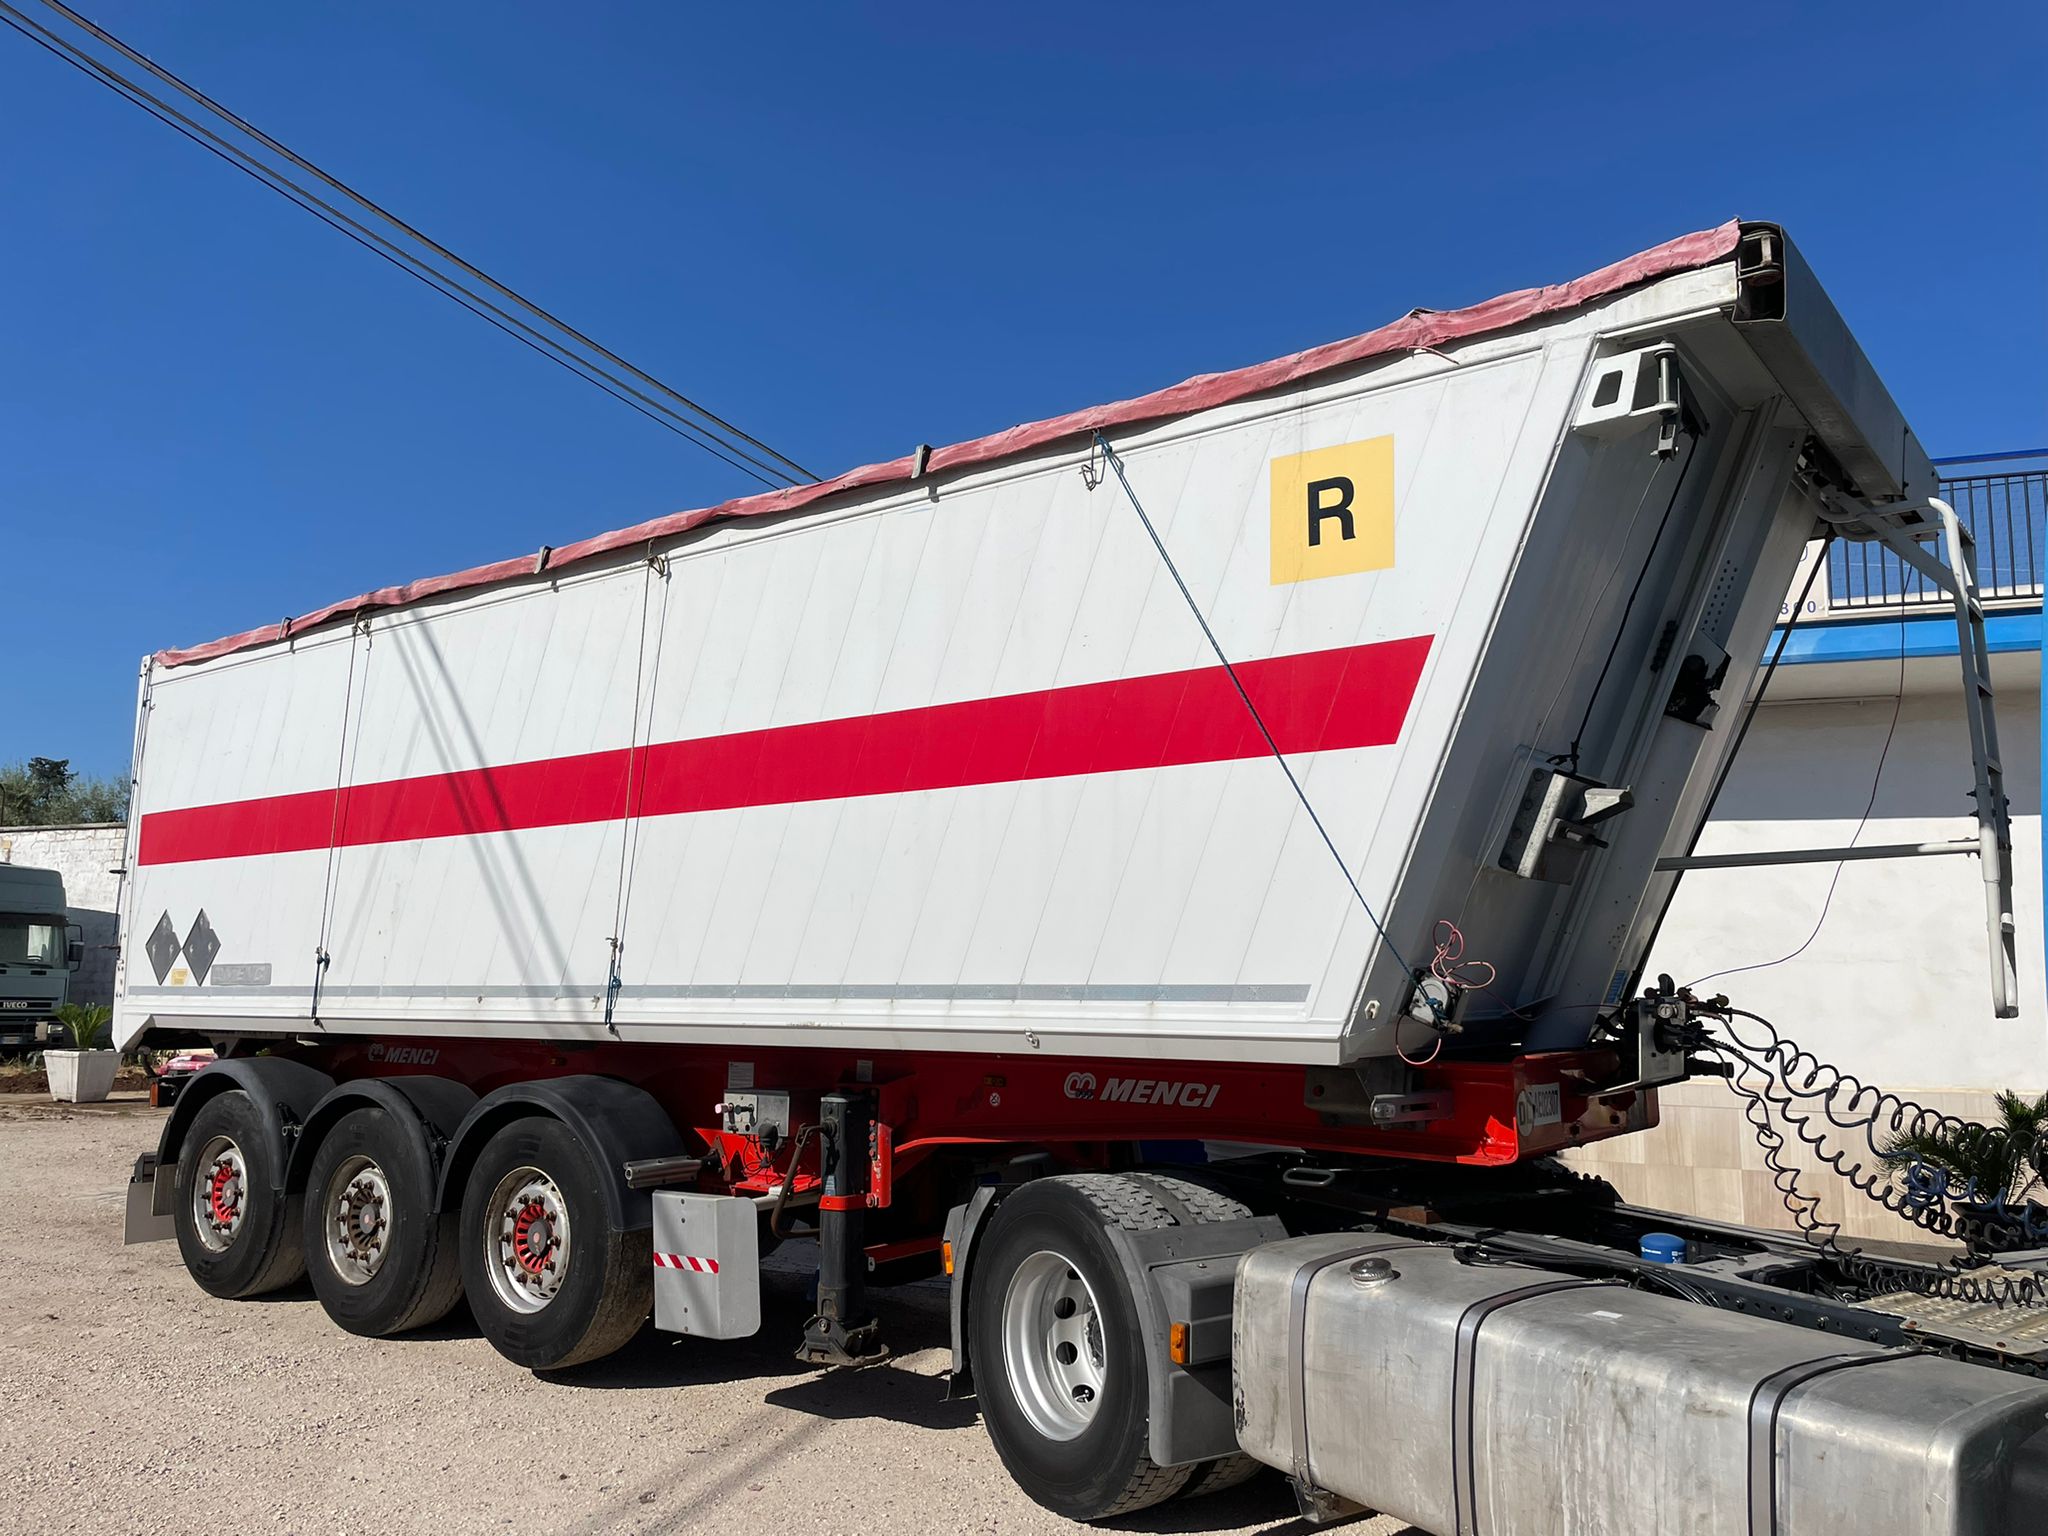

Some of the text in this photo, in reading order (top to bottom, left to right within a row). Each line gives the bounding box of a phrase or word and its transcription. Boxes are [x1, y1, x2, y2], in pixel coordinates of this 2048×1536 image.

[1307, 476, 1356, 547] R
[3, 1001, 28, 1009] IVECO
[383, 1047, 440, 1065] MENCI
[1099, 1077, 1221, 1108] MENCI
